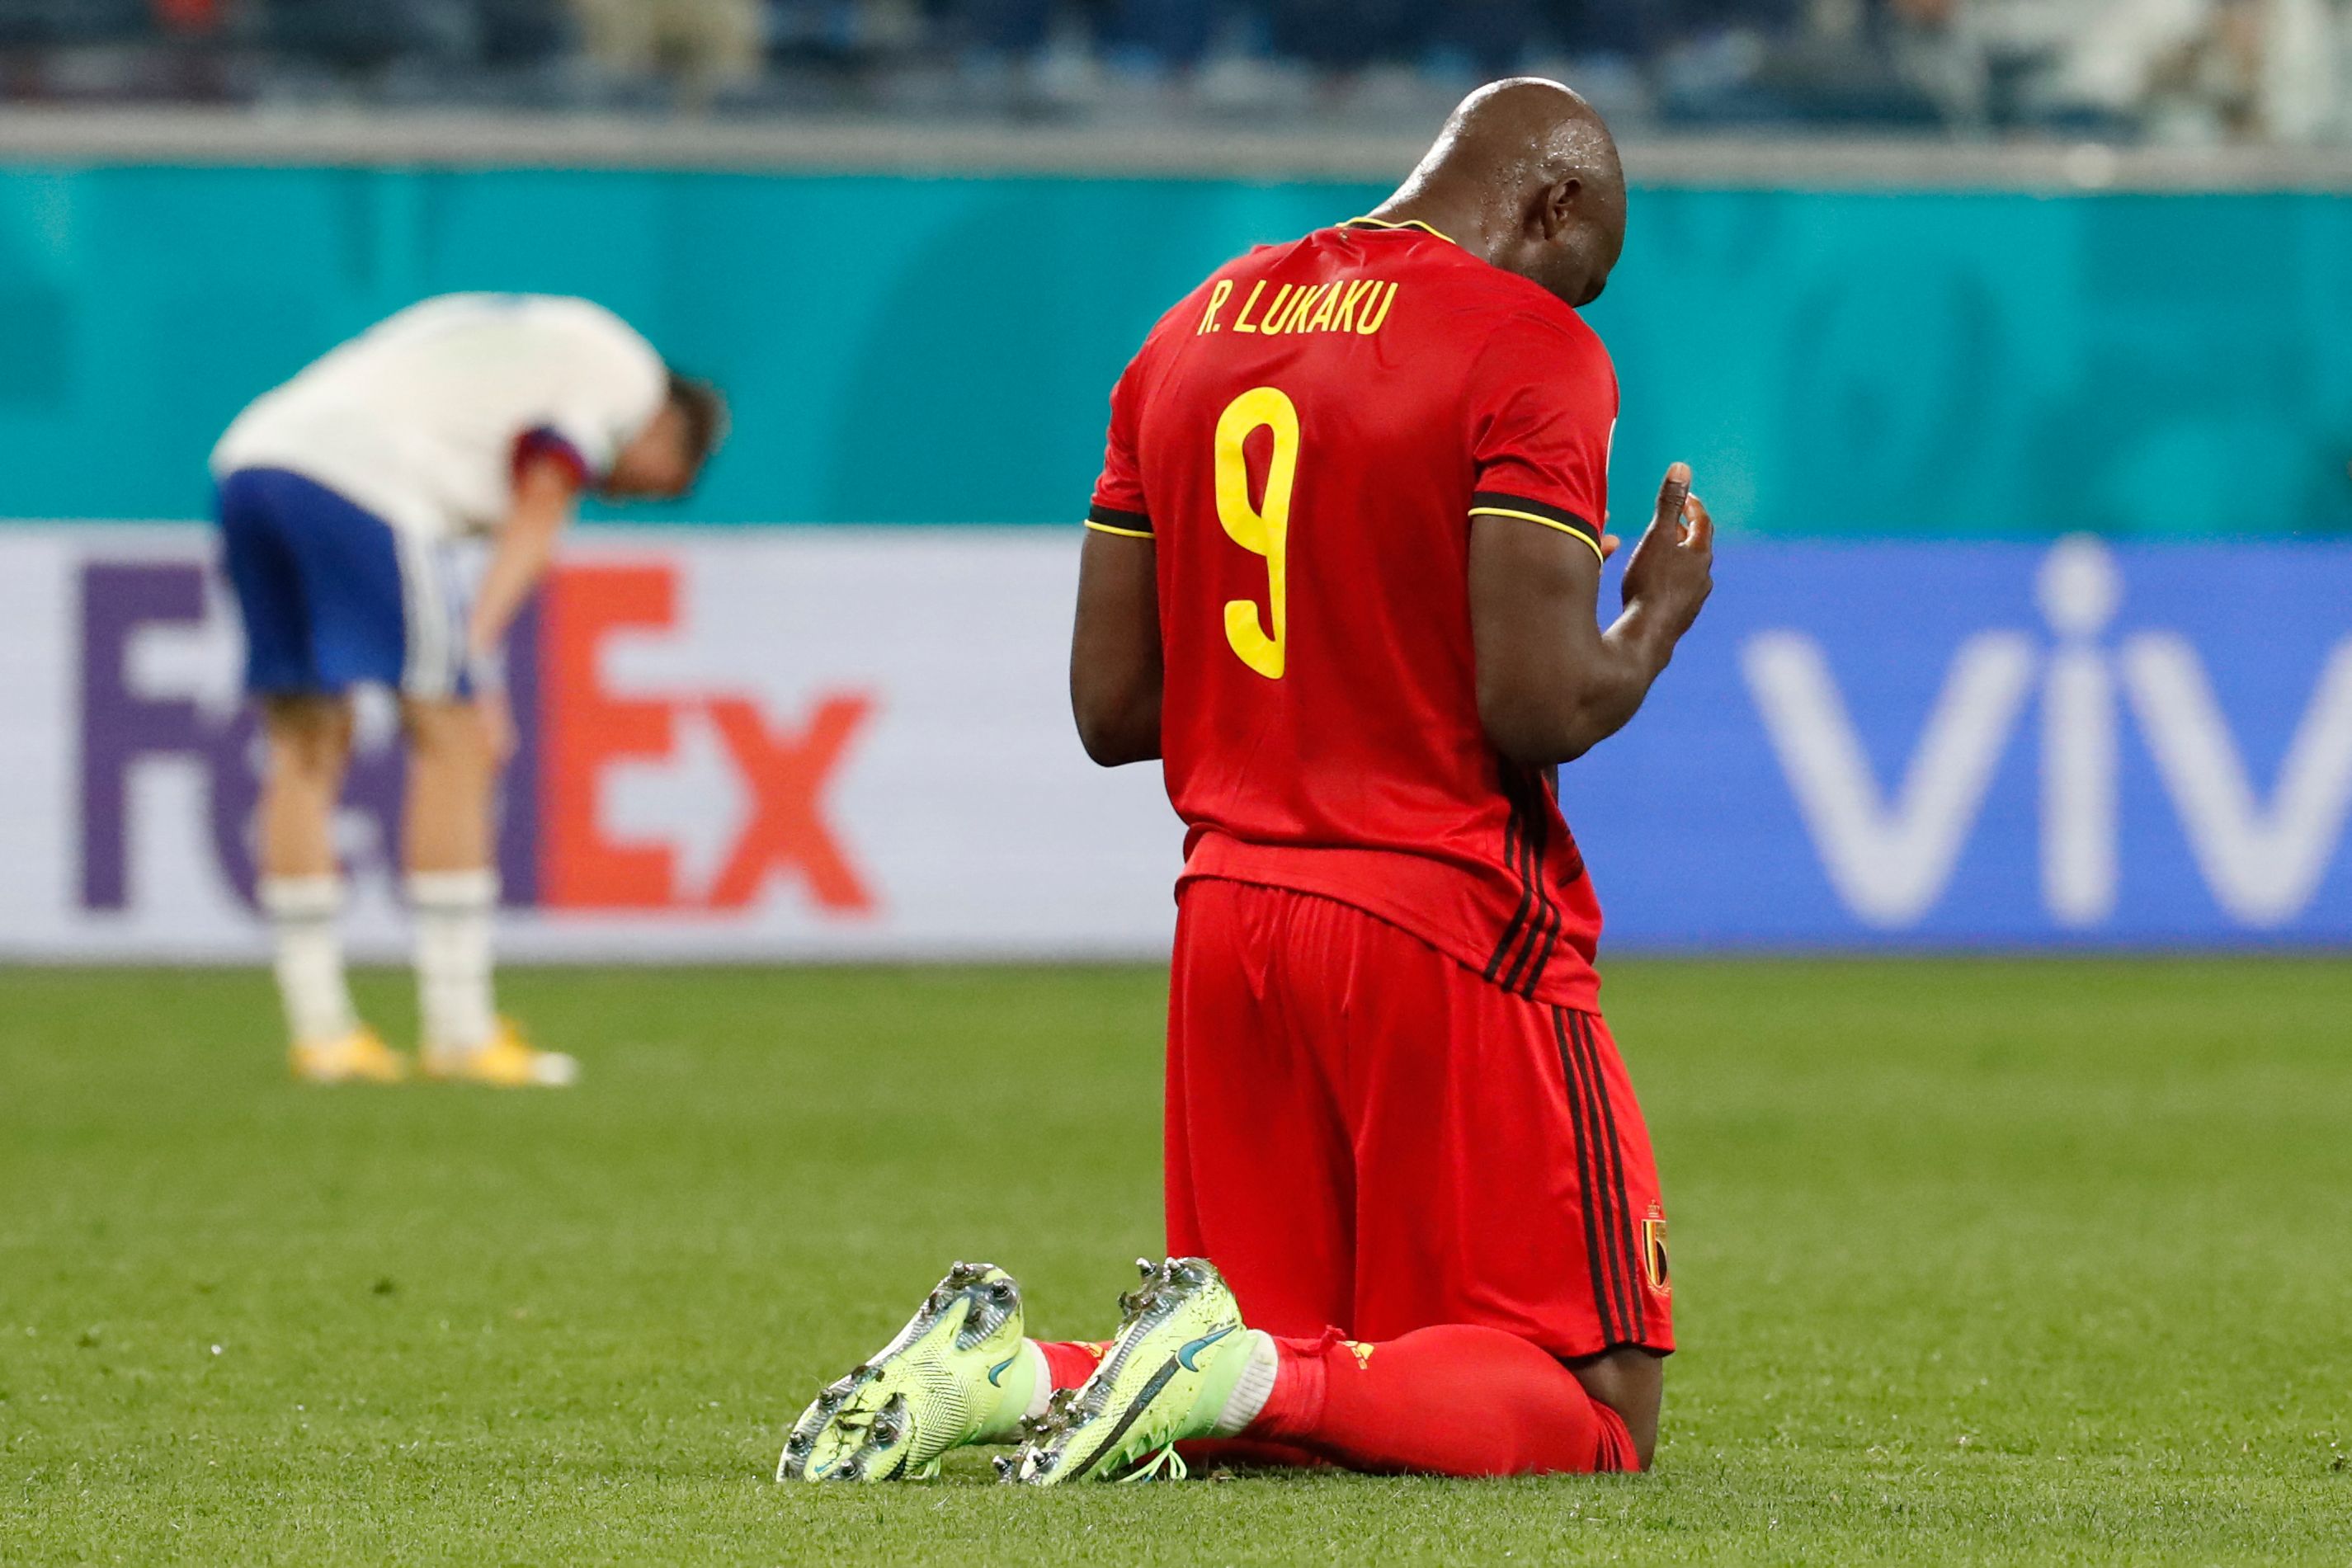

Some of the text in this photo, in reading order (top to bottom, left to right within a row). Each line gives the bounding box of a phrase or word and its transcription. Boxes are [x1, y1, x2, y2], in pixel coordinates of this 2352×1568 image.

[1196, 279, 1399, 337] R. LUKAKU
[1214, 385, 1300, 680] 9
